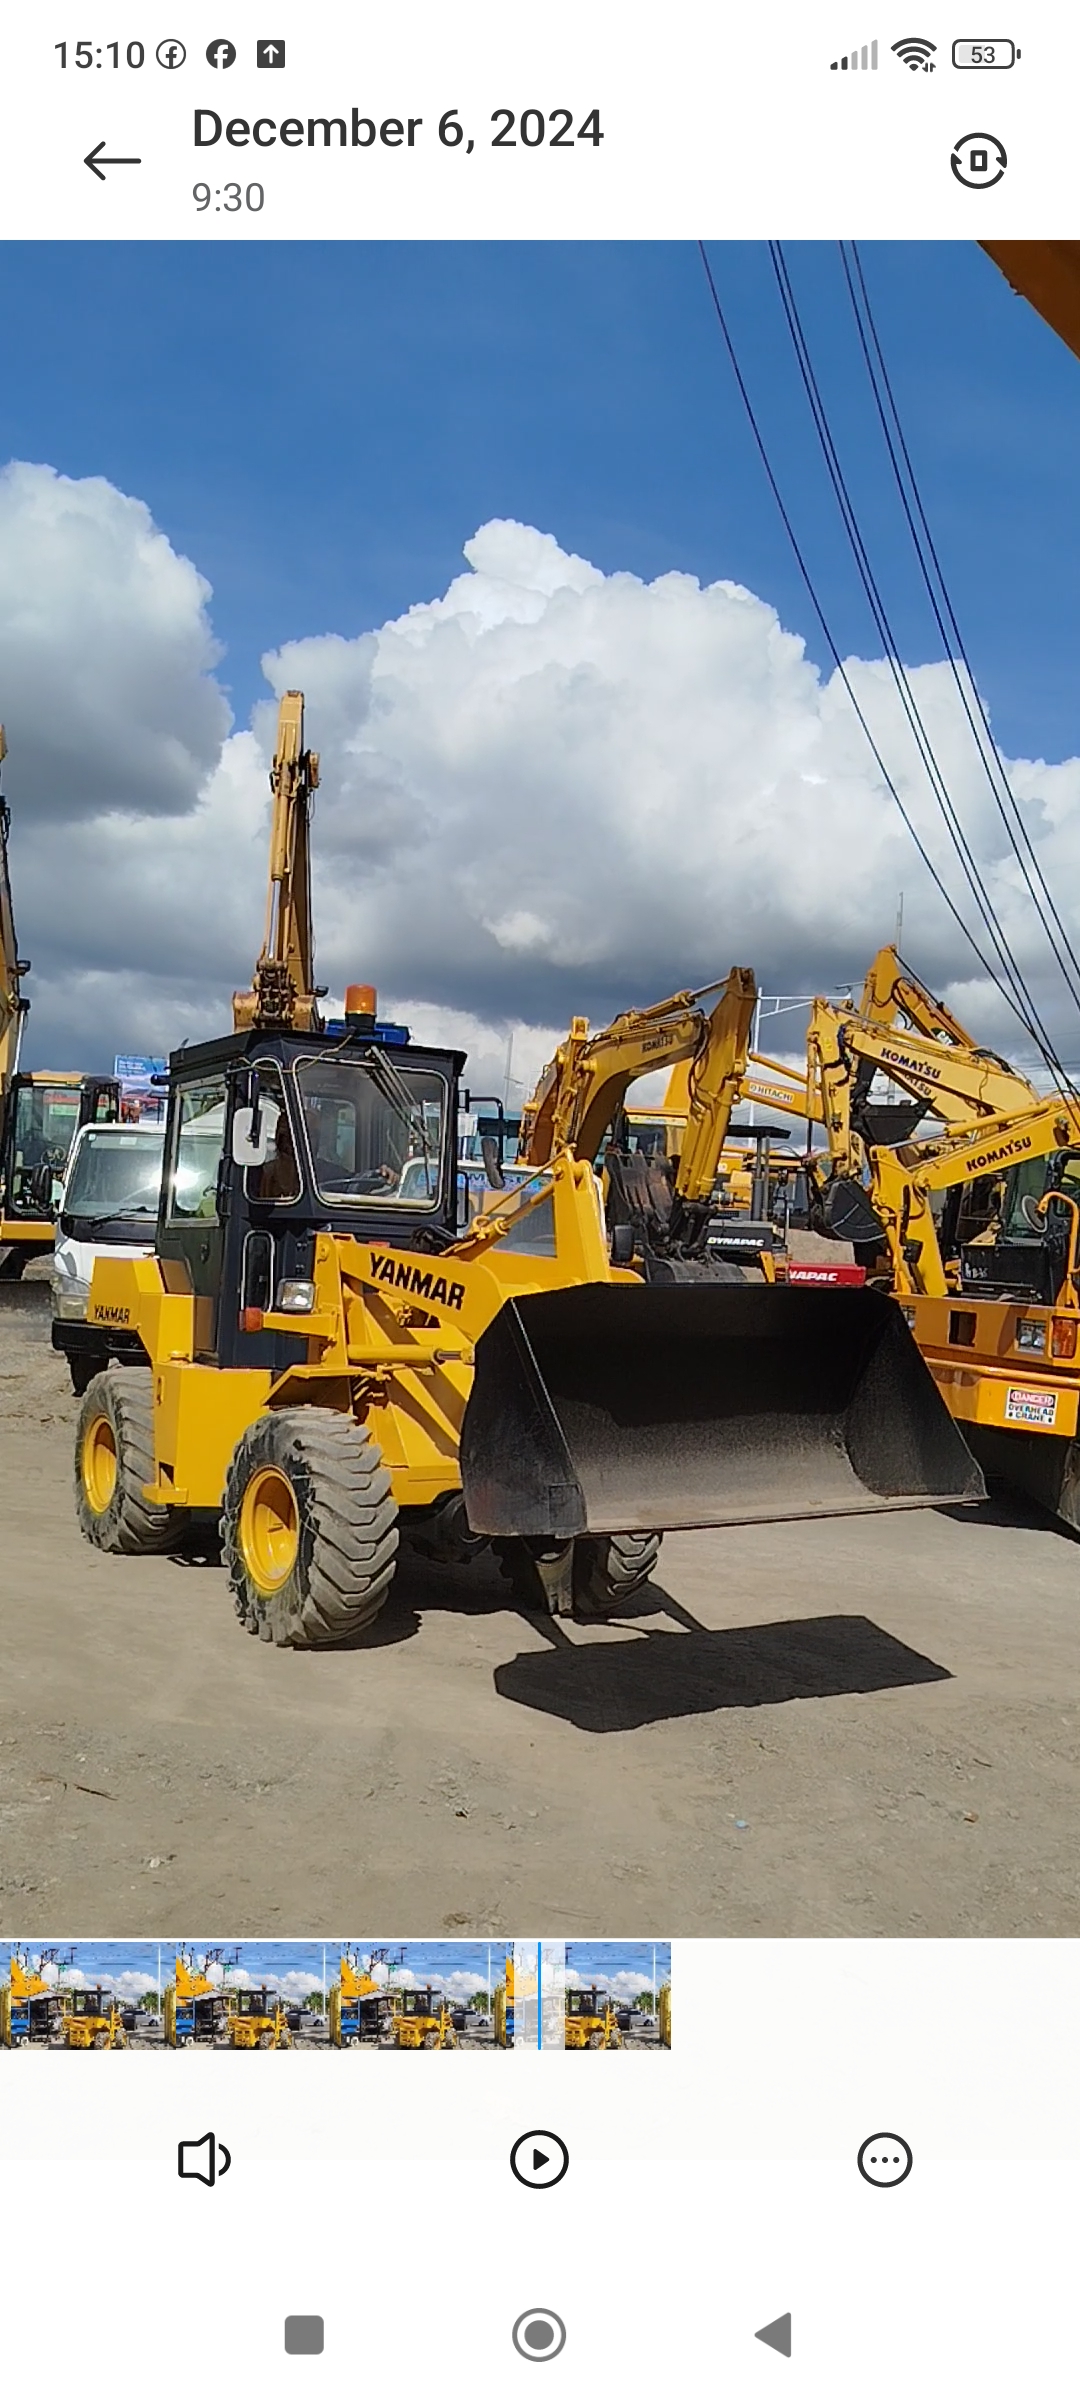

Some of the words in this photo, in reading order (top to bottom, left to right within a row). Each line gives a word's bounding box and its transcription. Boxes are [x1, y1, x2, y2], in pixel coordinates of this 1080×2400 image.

[757, 1086, 793, 1102] HITACHI
[707, 1236, 765, 1247] DYNAPAC
[369, 1252, 466, 1311] YANMAR
[94, 1303, 130, 1324] YANMAR
[1013, 1391, 1053, 1406] DANGER
[1008, 1403, 1054, 1416] OVERHEAD
[1015, 1412, 1044, 1422] CRANE
